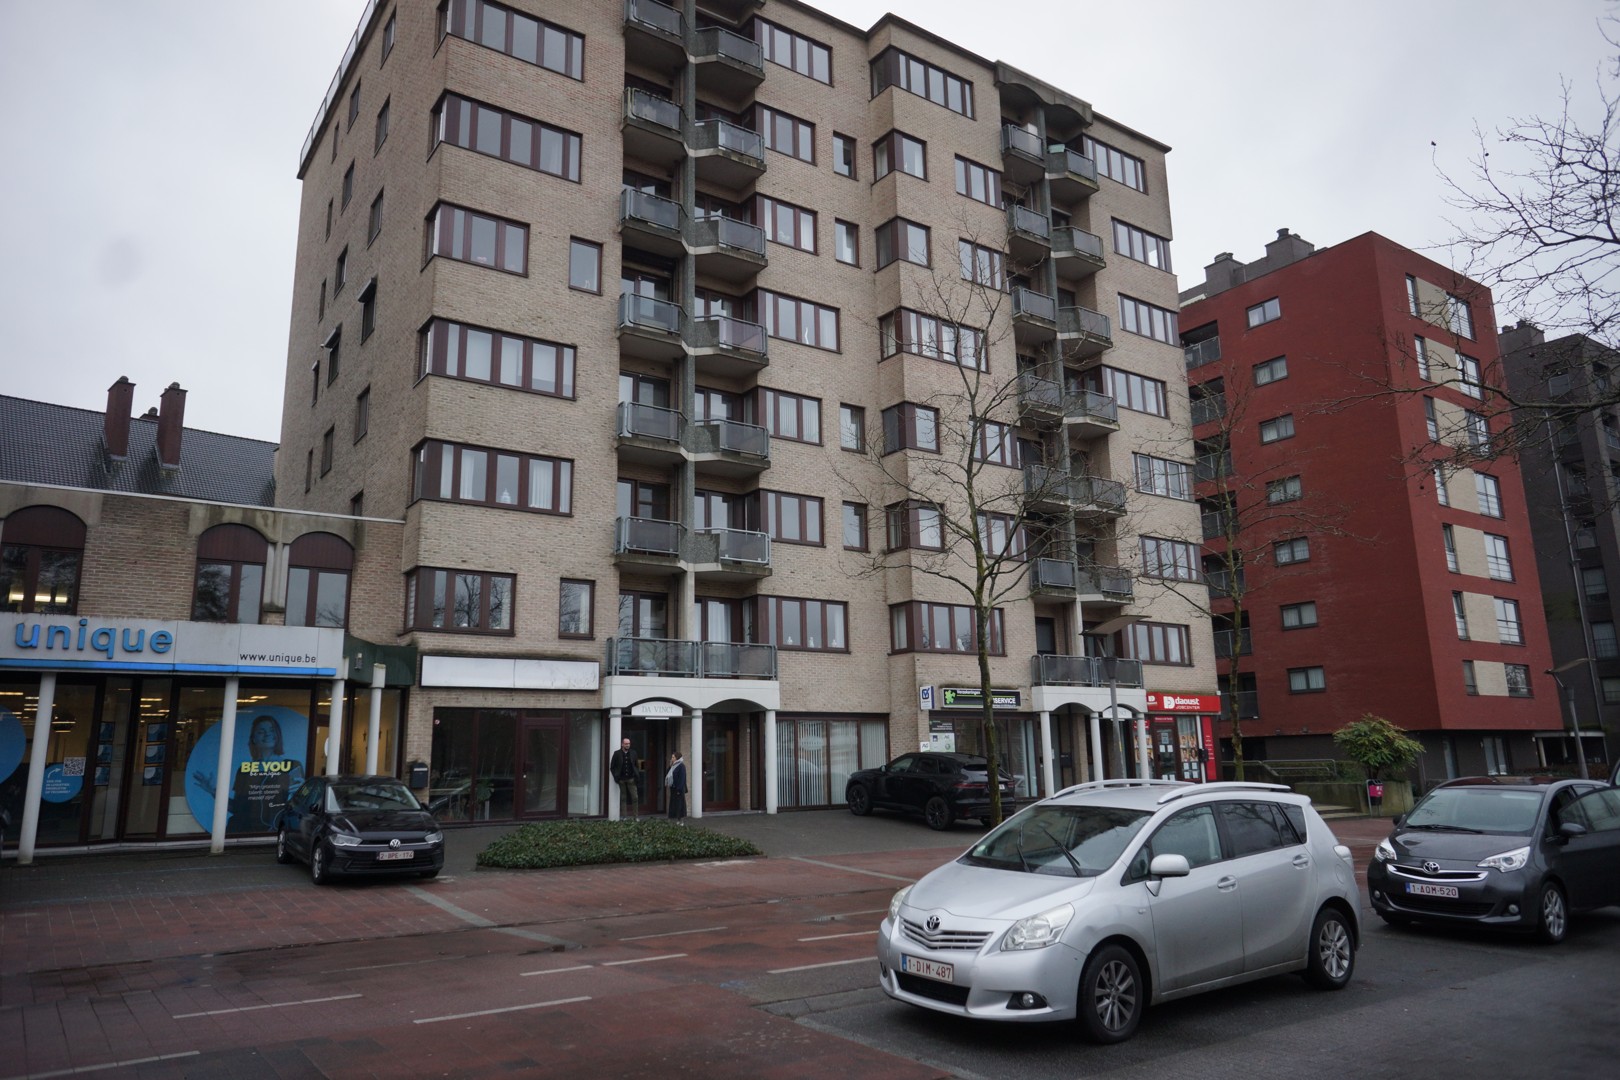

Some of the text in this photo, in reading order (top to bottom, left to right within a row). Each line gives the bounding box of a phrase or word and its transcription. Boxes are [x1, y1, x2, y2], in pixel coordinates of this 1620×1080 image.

[15, 618, 173, 660] unique
[239, 653, 317, 665] www.unique.be
[1175, 696, 1200, 705] daoust
[641, 705, 674, 713] DA VINCI
[241, 761, 292, 773] BE YOU
[908, 958, 952, 980] 1-DIM-487
